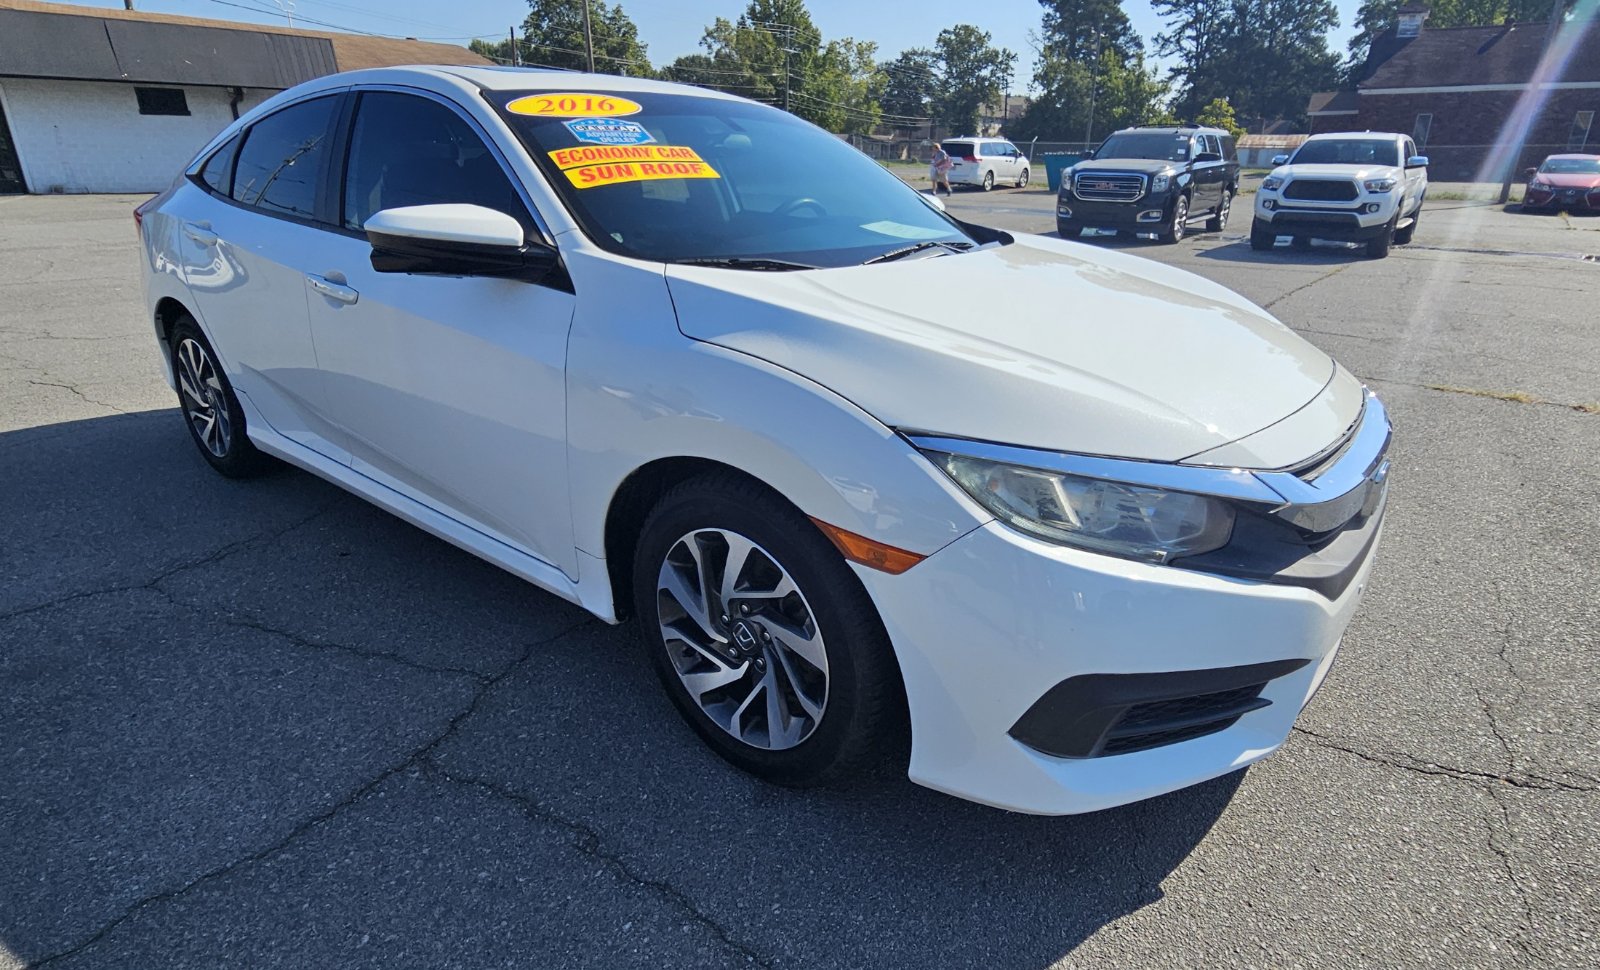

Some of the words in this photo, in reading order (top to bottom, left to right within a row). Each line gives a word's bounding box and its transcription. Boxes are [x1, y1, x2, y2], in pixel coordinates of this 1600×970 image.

[537, 97, 615, 114] 2016
[555, 147, 651, 165] ECONOMY
[656, 147, 694, 159] CAR
[578, 164, 634, 183] SUN
[640, 163, 703, 176] ROOF
